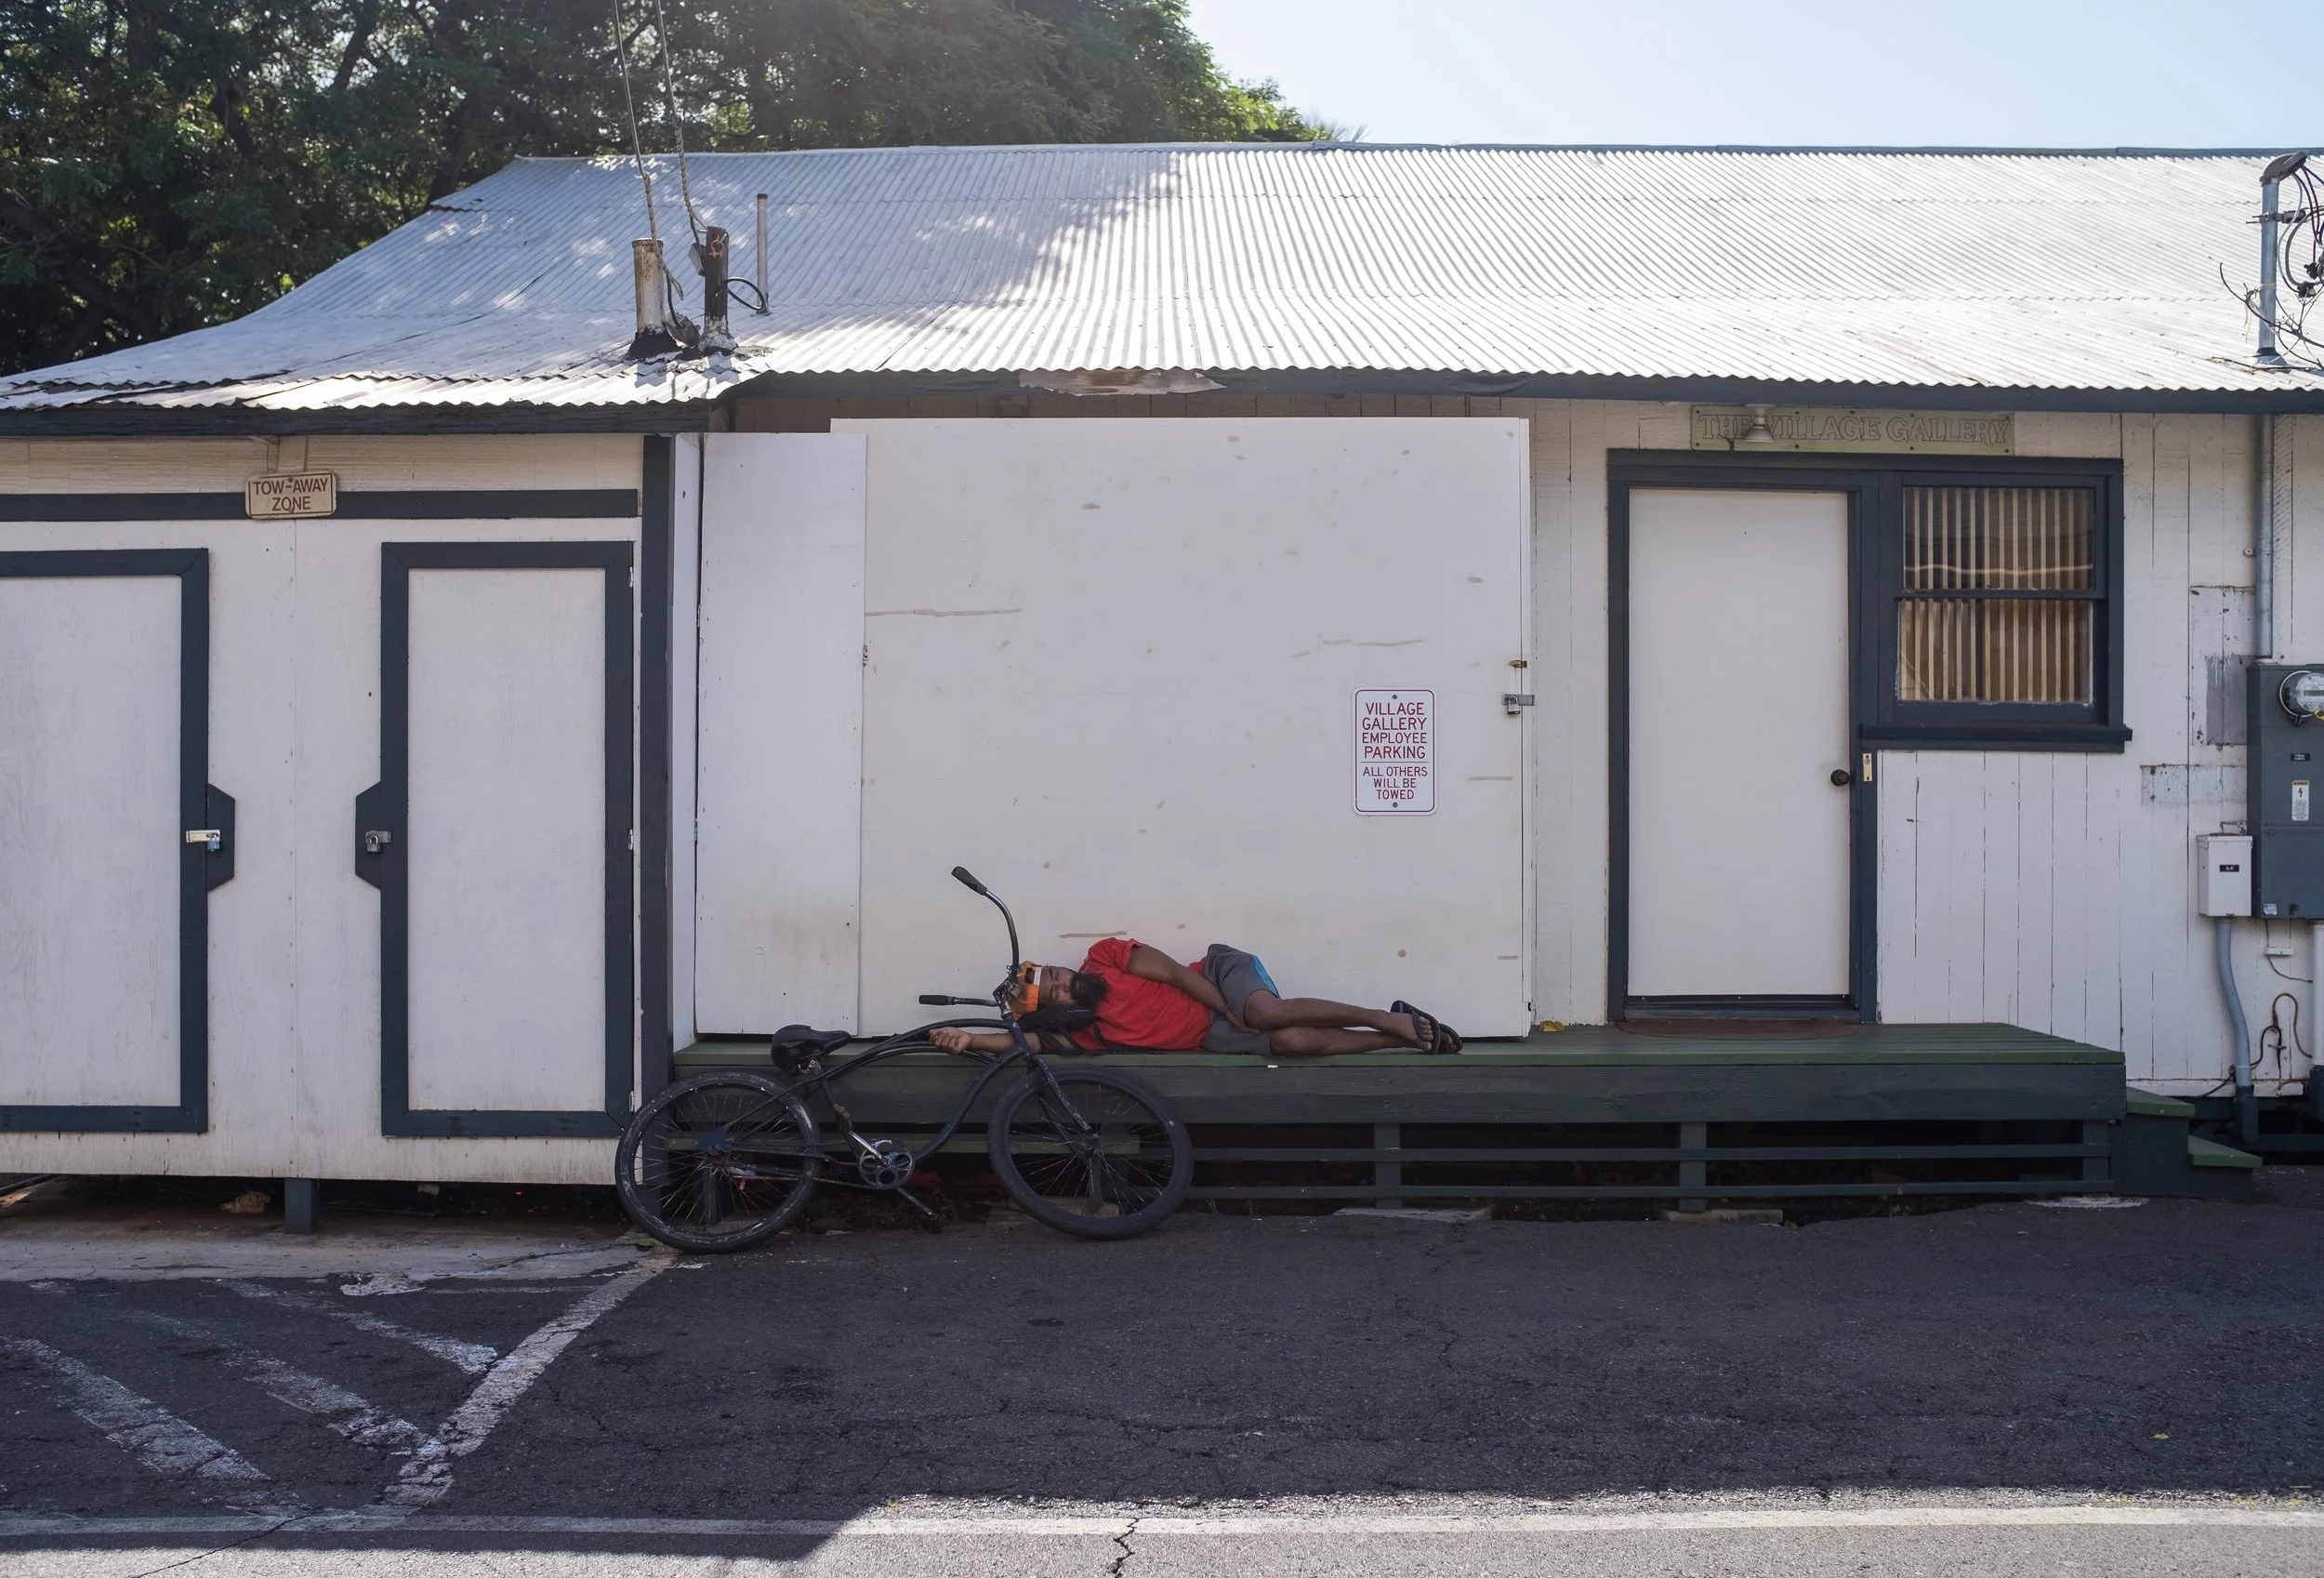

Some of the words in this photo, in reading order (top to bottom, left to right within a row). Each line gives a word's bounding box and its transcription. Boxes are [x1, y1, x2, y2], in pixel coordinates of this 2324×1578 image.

[1698, 415, 1754, 440] THE
[1885, 417, 2011, 446] GALLERY
[253, 477, 328, 496] TOW-AWAY
[271, 496, 311, 511] ZONE
[1365, 702, 1425, 715] VILLAGE
[1362, 717, 1427, 731] GALLERY
[1362, 732, 1428, 744] EMPLOYEE
[1364, 746, 1426, 759] PARKING
[1362, 766, 1383, 776] ALL
[1386, 766, 1428, 776] OTHERS
[1373, 778, 1400, 789] WILL
[1403, 778, 1417, 789] BE
[1376, 789, 1415, 800] TOWED
